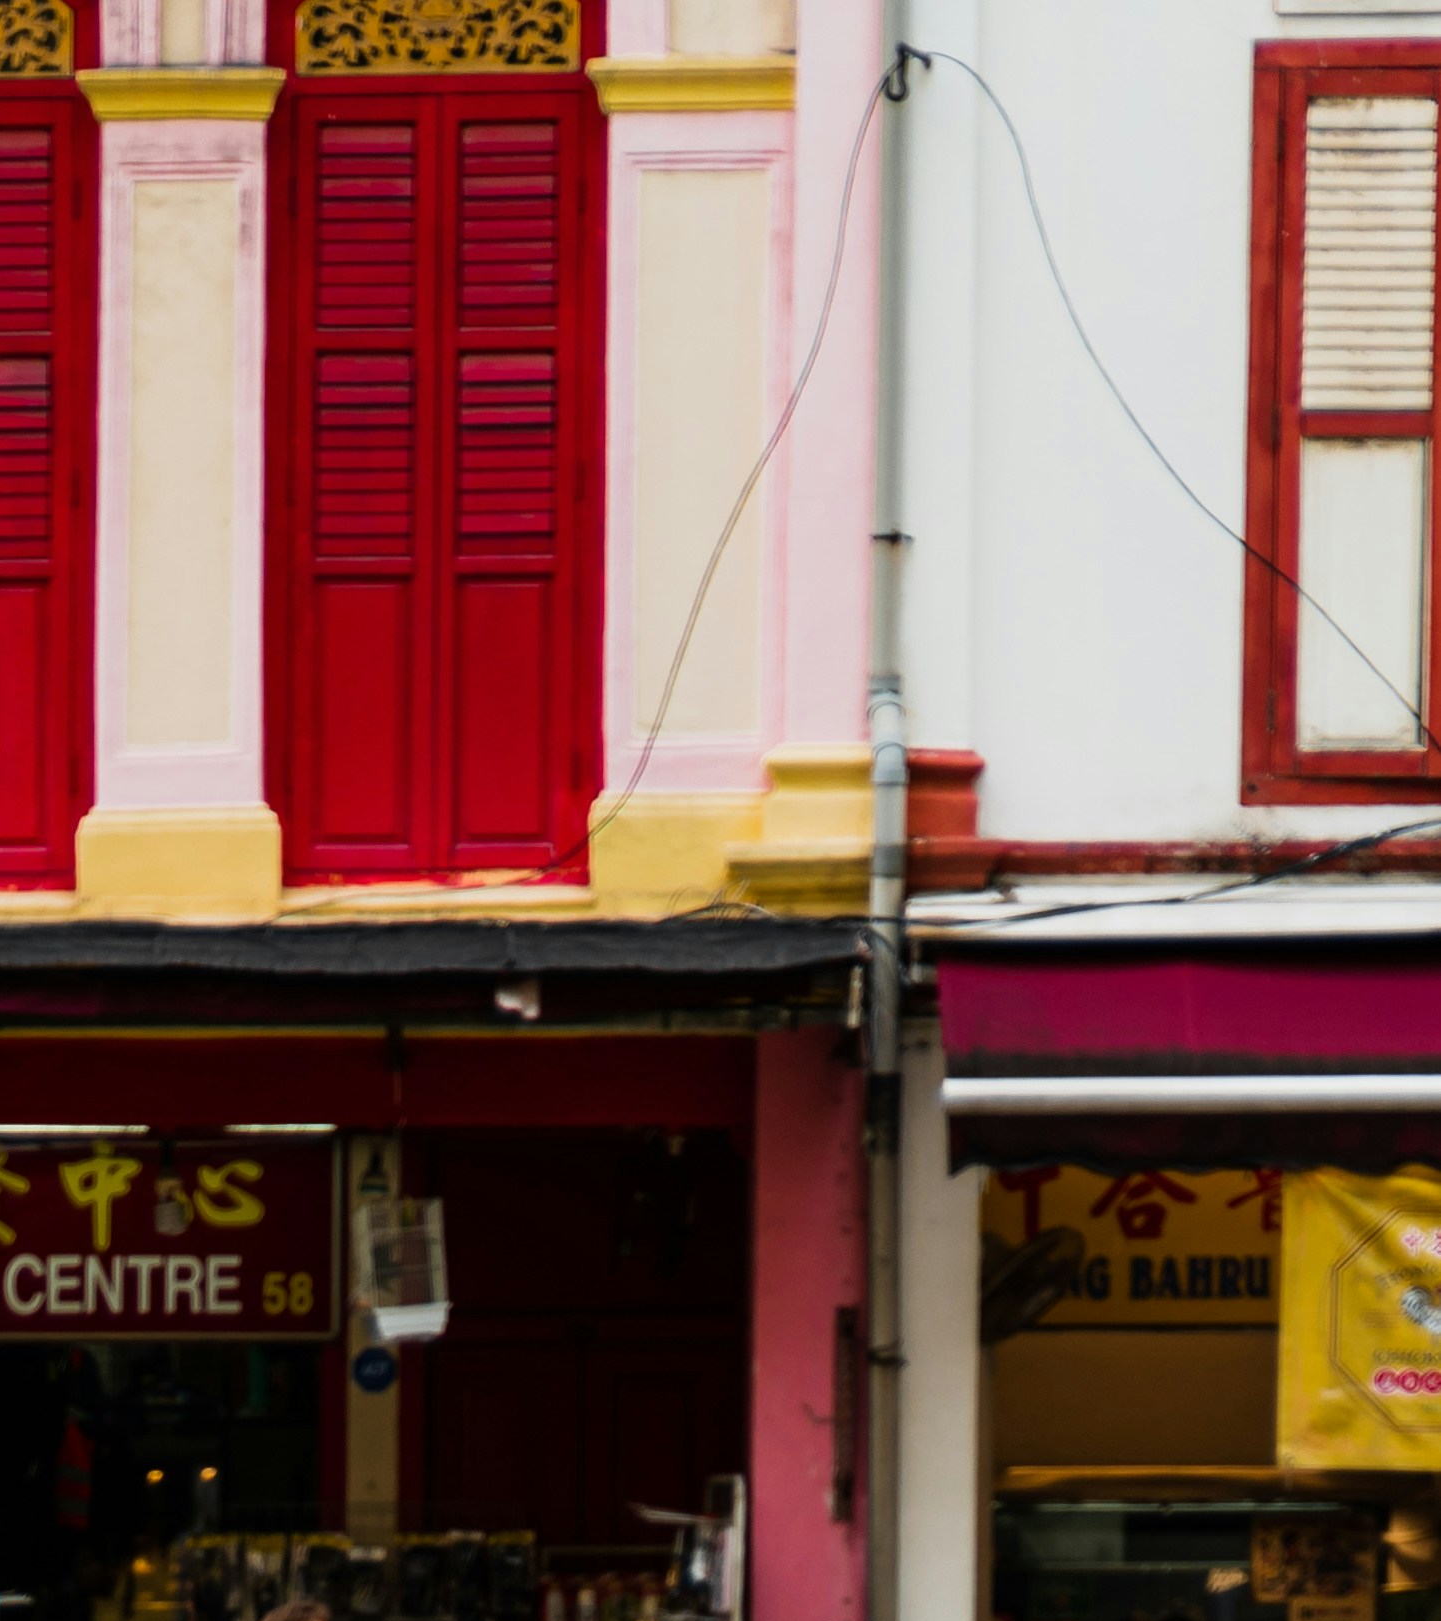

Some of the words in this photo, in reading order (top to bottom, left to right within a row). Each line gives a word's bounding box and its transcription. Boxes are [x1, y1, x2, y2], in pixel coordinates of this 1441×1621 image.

[2, 1254, 244, 1316] CENTRE
[261, 1272, 315, 1315] 58
[1129, 1255, 1272, 1300] BAHRU
